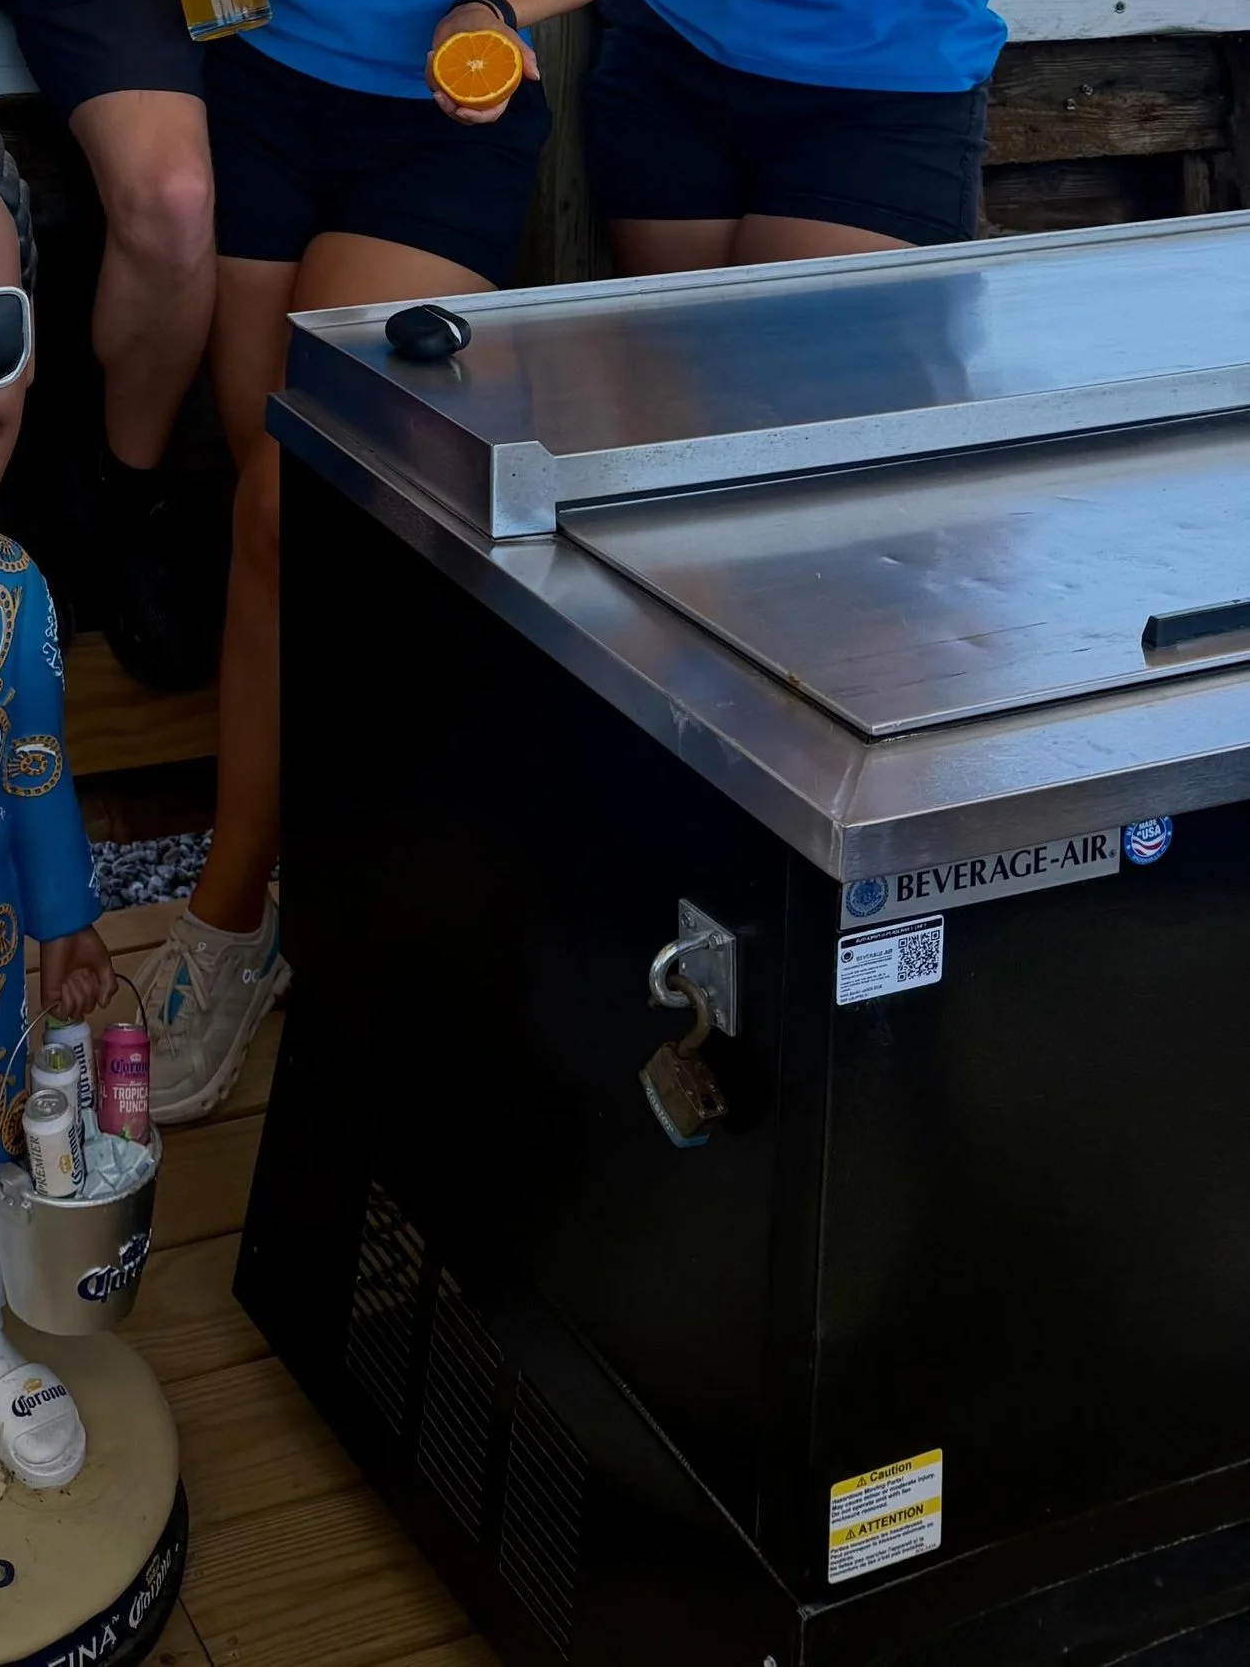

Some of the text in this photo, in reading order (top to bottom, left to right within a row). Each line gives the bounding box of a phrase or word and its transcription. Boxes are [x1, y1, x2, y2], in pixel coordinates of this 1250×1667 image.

[1142, 825, 1161, 840] USA
[896, 834, 1108, 903] BEVERAGE-AIR
[119, 1100, 148, 1114] PUNCH
[29, 1135, 47, 1197] PREMIER
[10, 1383, 68, 1418] Corona
[870, 1461, 912, 1482] Caution
[858, 1504, 924, 1536] ATTENTION
